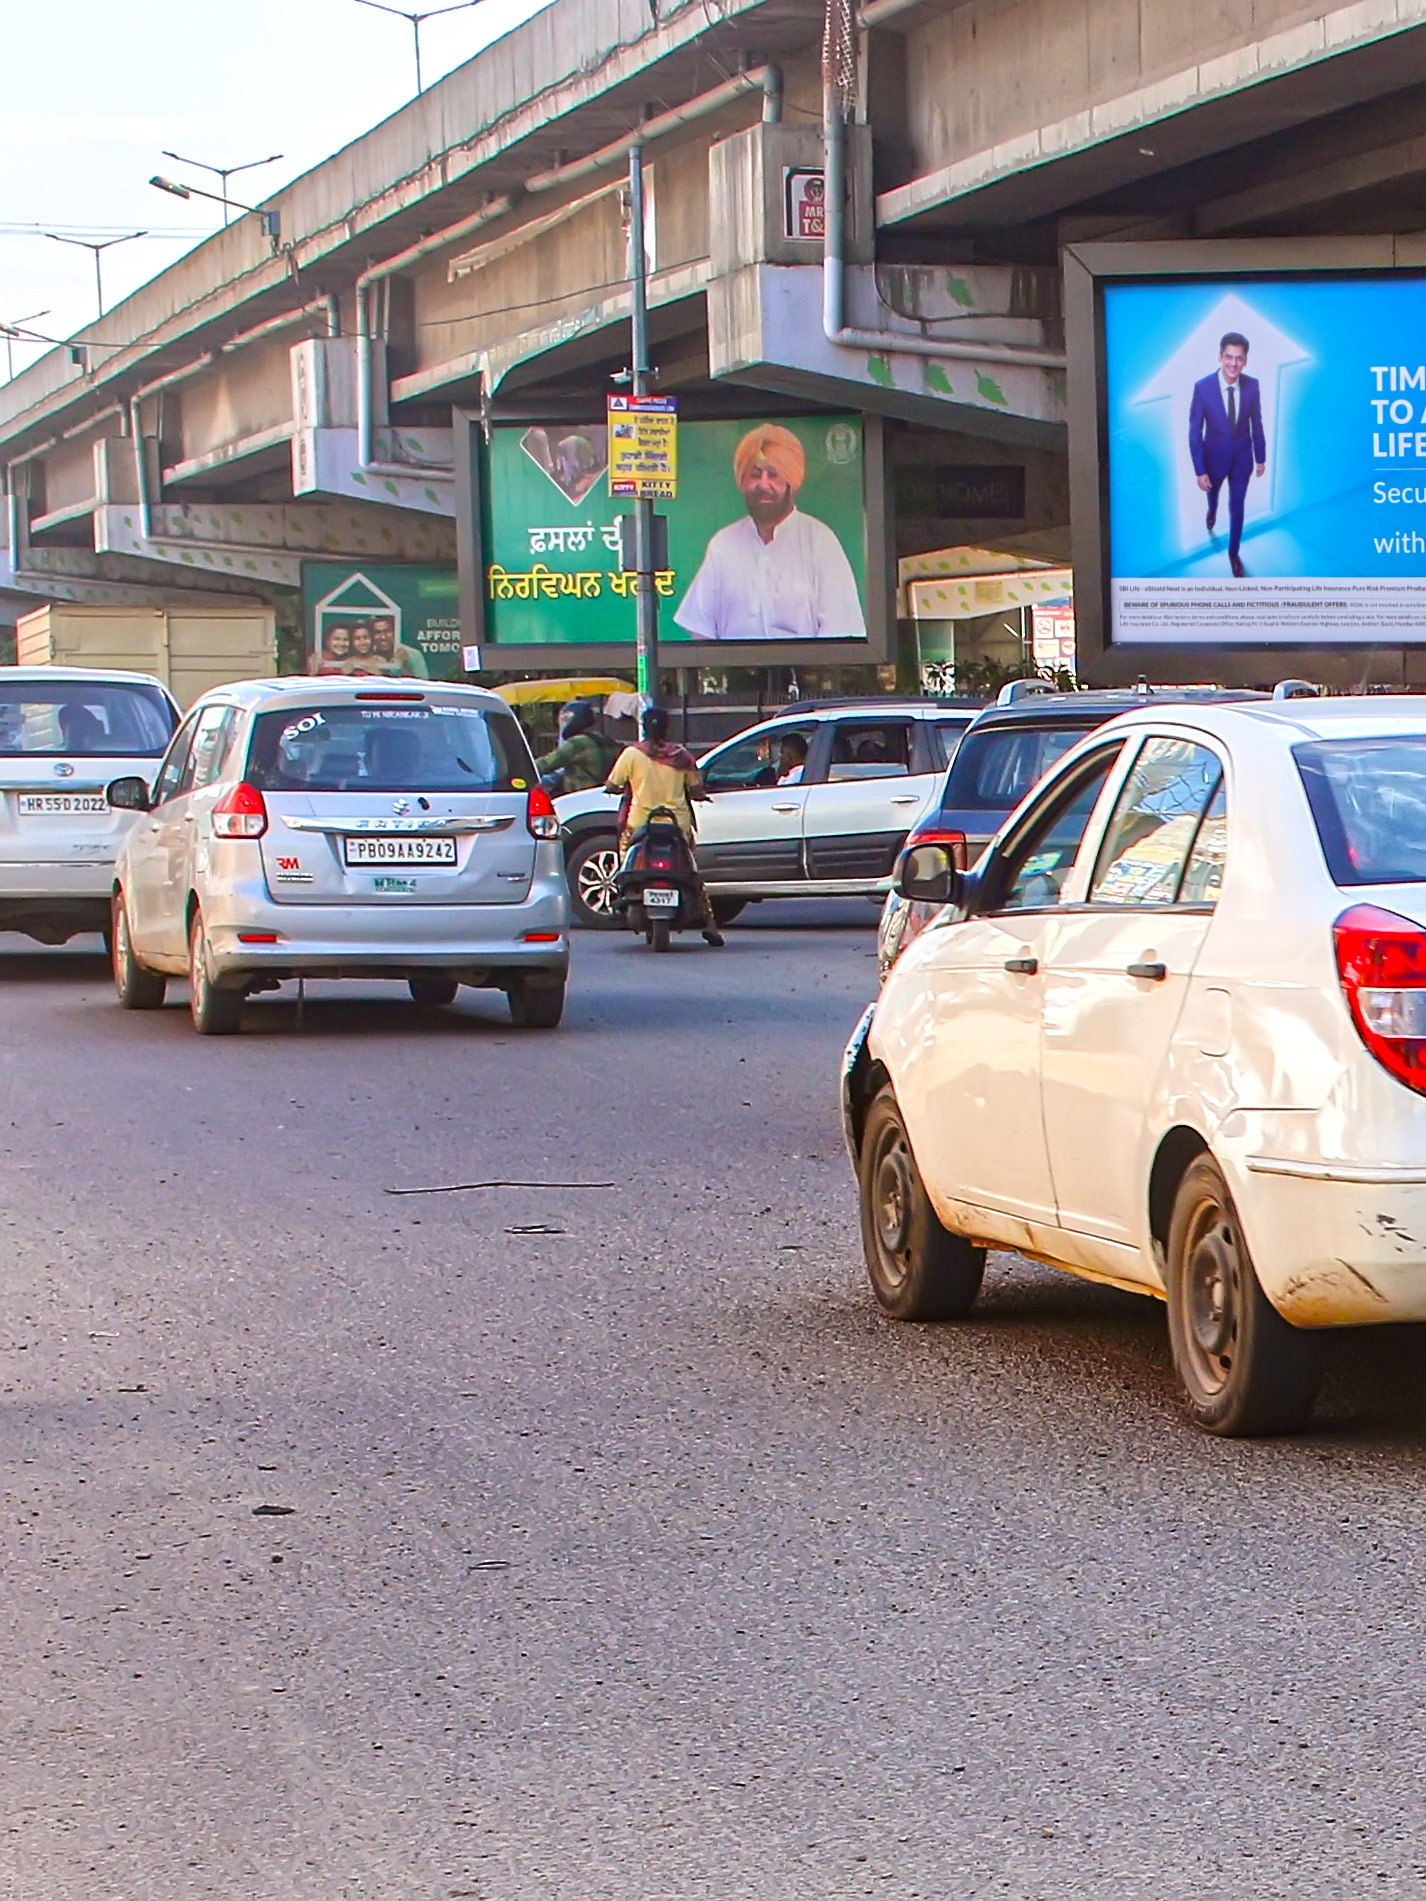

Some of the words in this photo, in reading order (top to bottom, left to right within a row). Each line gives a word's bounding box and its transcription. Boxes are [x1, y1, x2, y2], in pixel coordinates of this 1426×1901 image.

[1371, 399, 1413, 424] TO
[1373, 531, 1425, 554] with
[489, 563, 602, 599] ਨਿਰਵਿਘਨ
[608, 570, 676, 597] ਖਰਦ
[417, 630, 461, 640] AFFOR
[421, 642, 460, 652] TOMO
[283, 711, 327, 741] SOI
[357, 843, 453, 858] PB09AA9242
